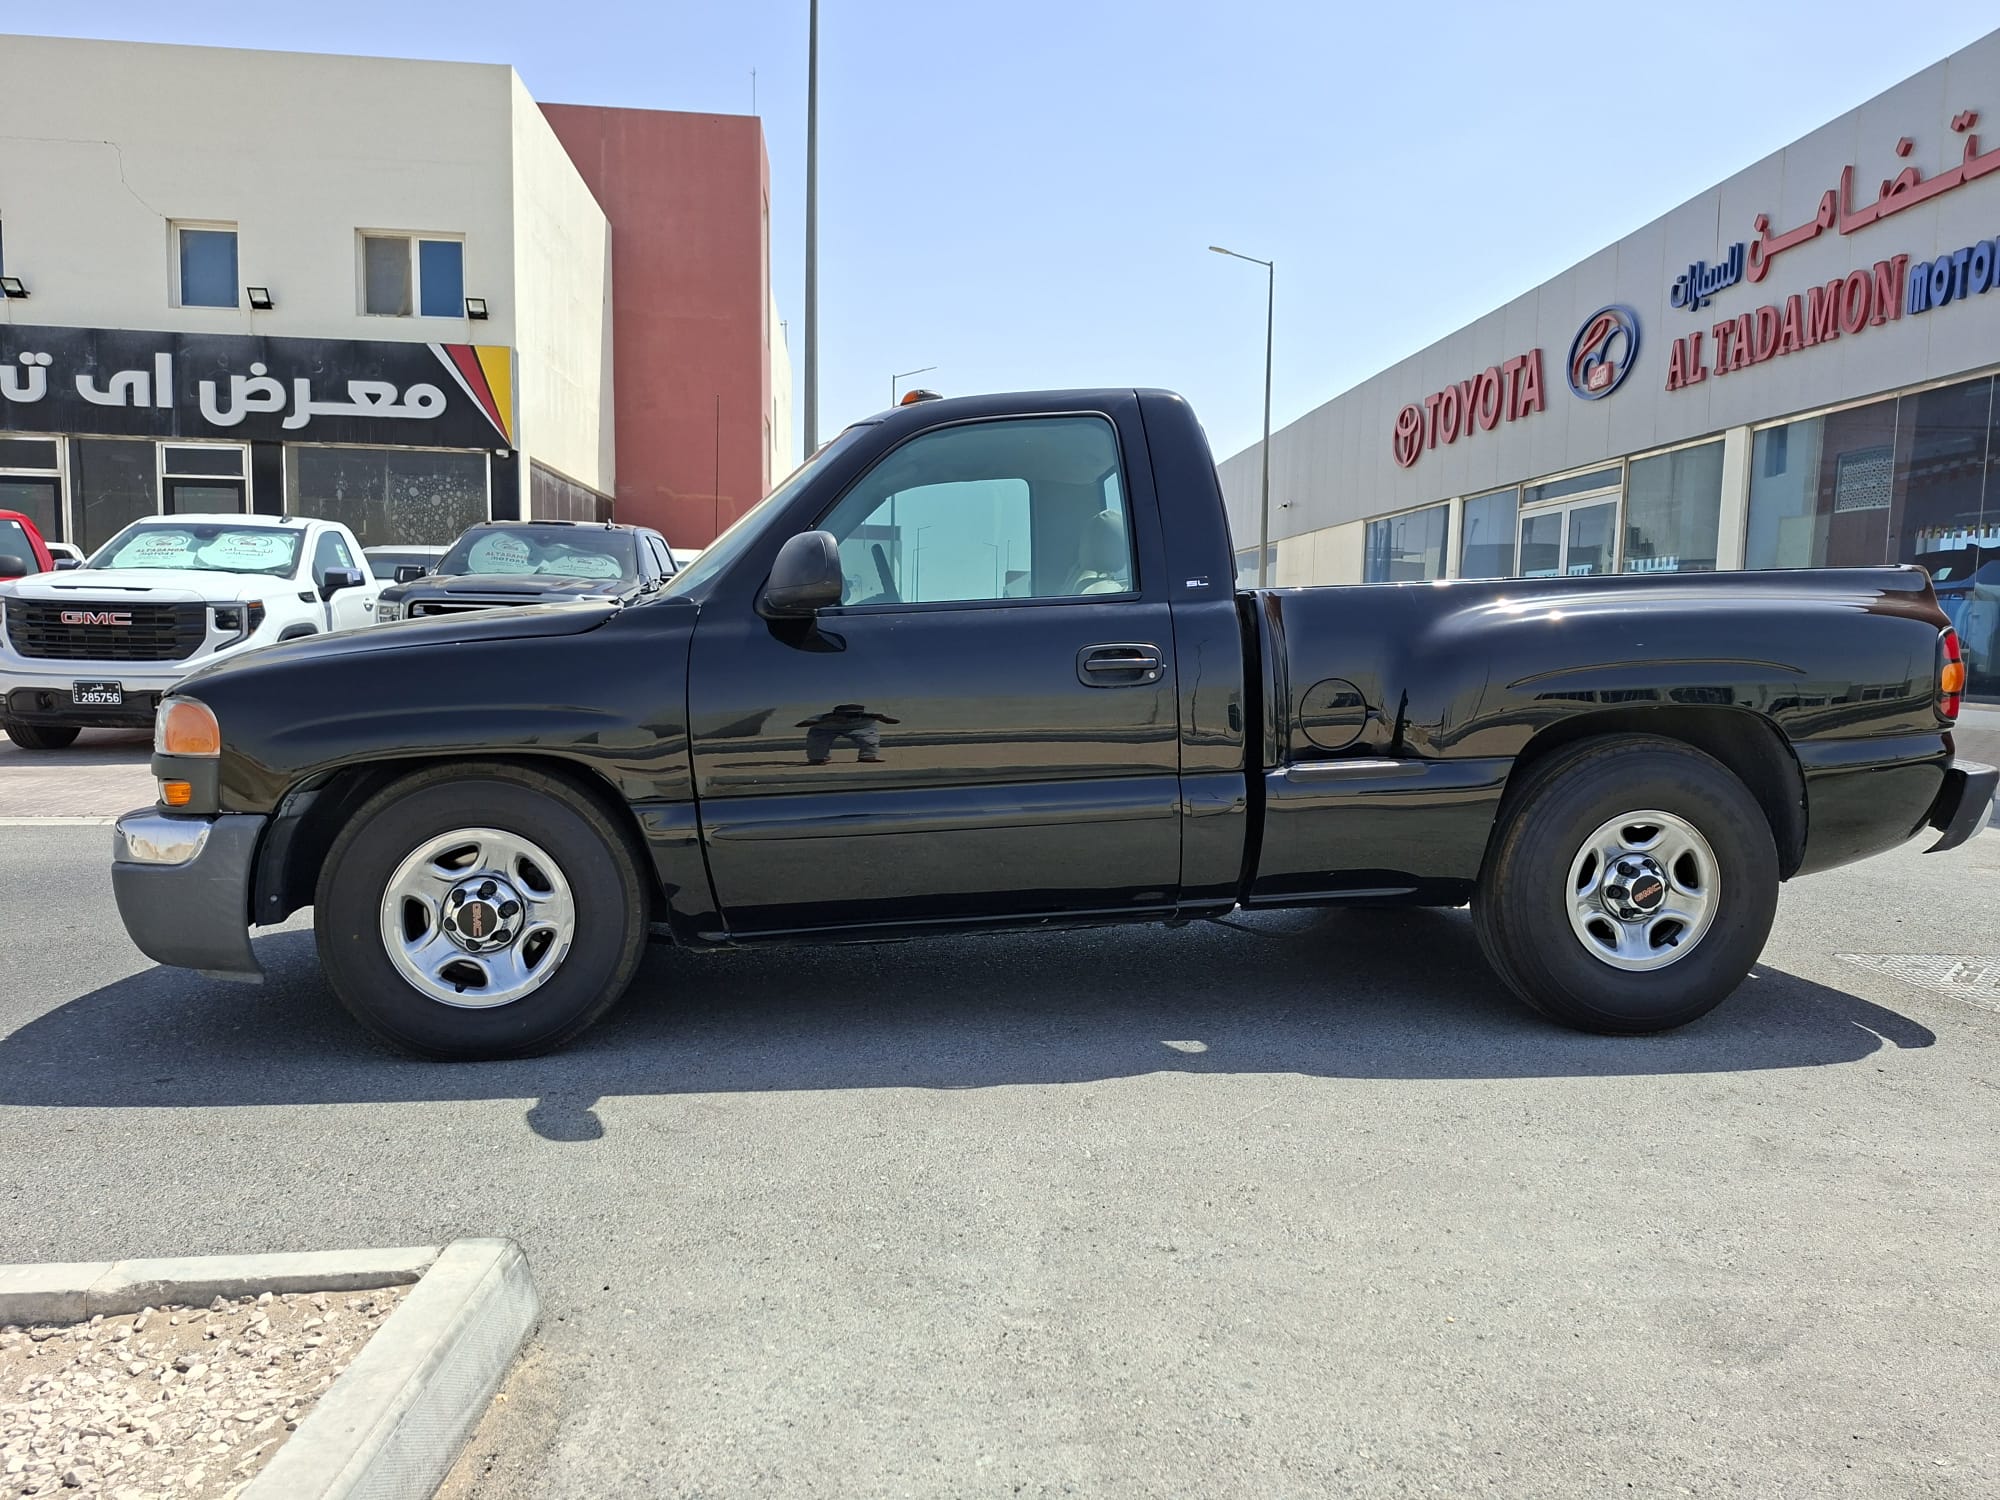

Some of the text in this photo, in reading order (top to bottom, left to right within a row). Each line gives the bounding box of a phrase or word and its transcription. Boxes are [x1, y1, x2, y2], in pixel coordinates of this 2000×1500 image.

[1746, 110, 2000, 283] تضامن
[1665, 236, 2000, 391] AL TADAMON MOTO
[199, 362, 447, 429] معرض
[1425, 348, 1545, 449] TOYOTA
[1186, 579, 1208, 587] SL
[61, 611, 132, 625] GMC
[81, 692, 120, 702] 285756
[472, 903, 482, 936] GMC
